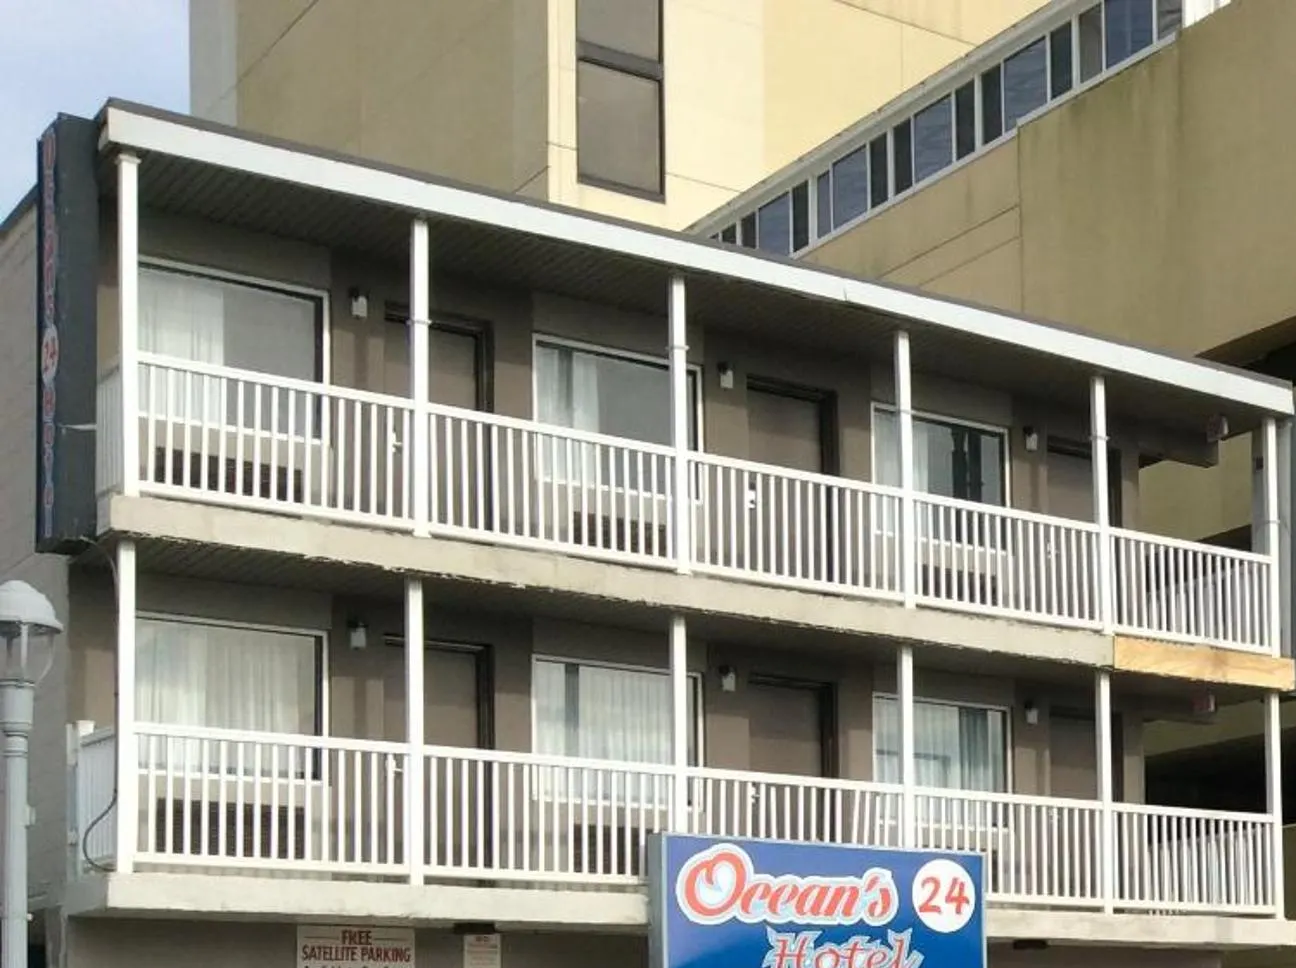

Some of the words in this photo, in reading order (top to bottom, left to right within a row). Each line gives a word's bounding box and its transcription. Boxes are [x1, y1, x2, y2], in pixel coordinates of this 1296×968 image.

[680, 846, 896, 921] Ocean's
[917, 875, 971, 917] 24
[341, 929, 373, 946] FREE
[302, 945, 358, 962] SATELLITE
[360, 946, 411, 963] PARKING
